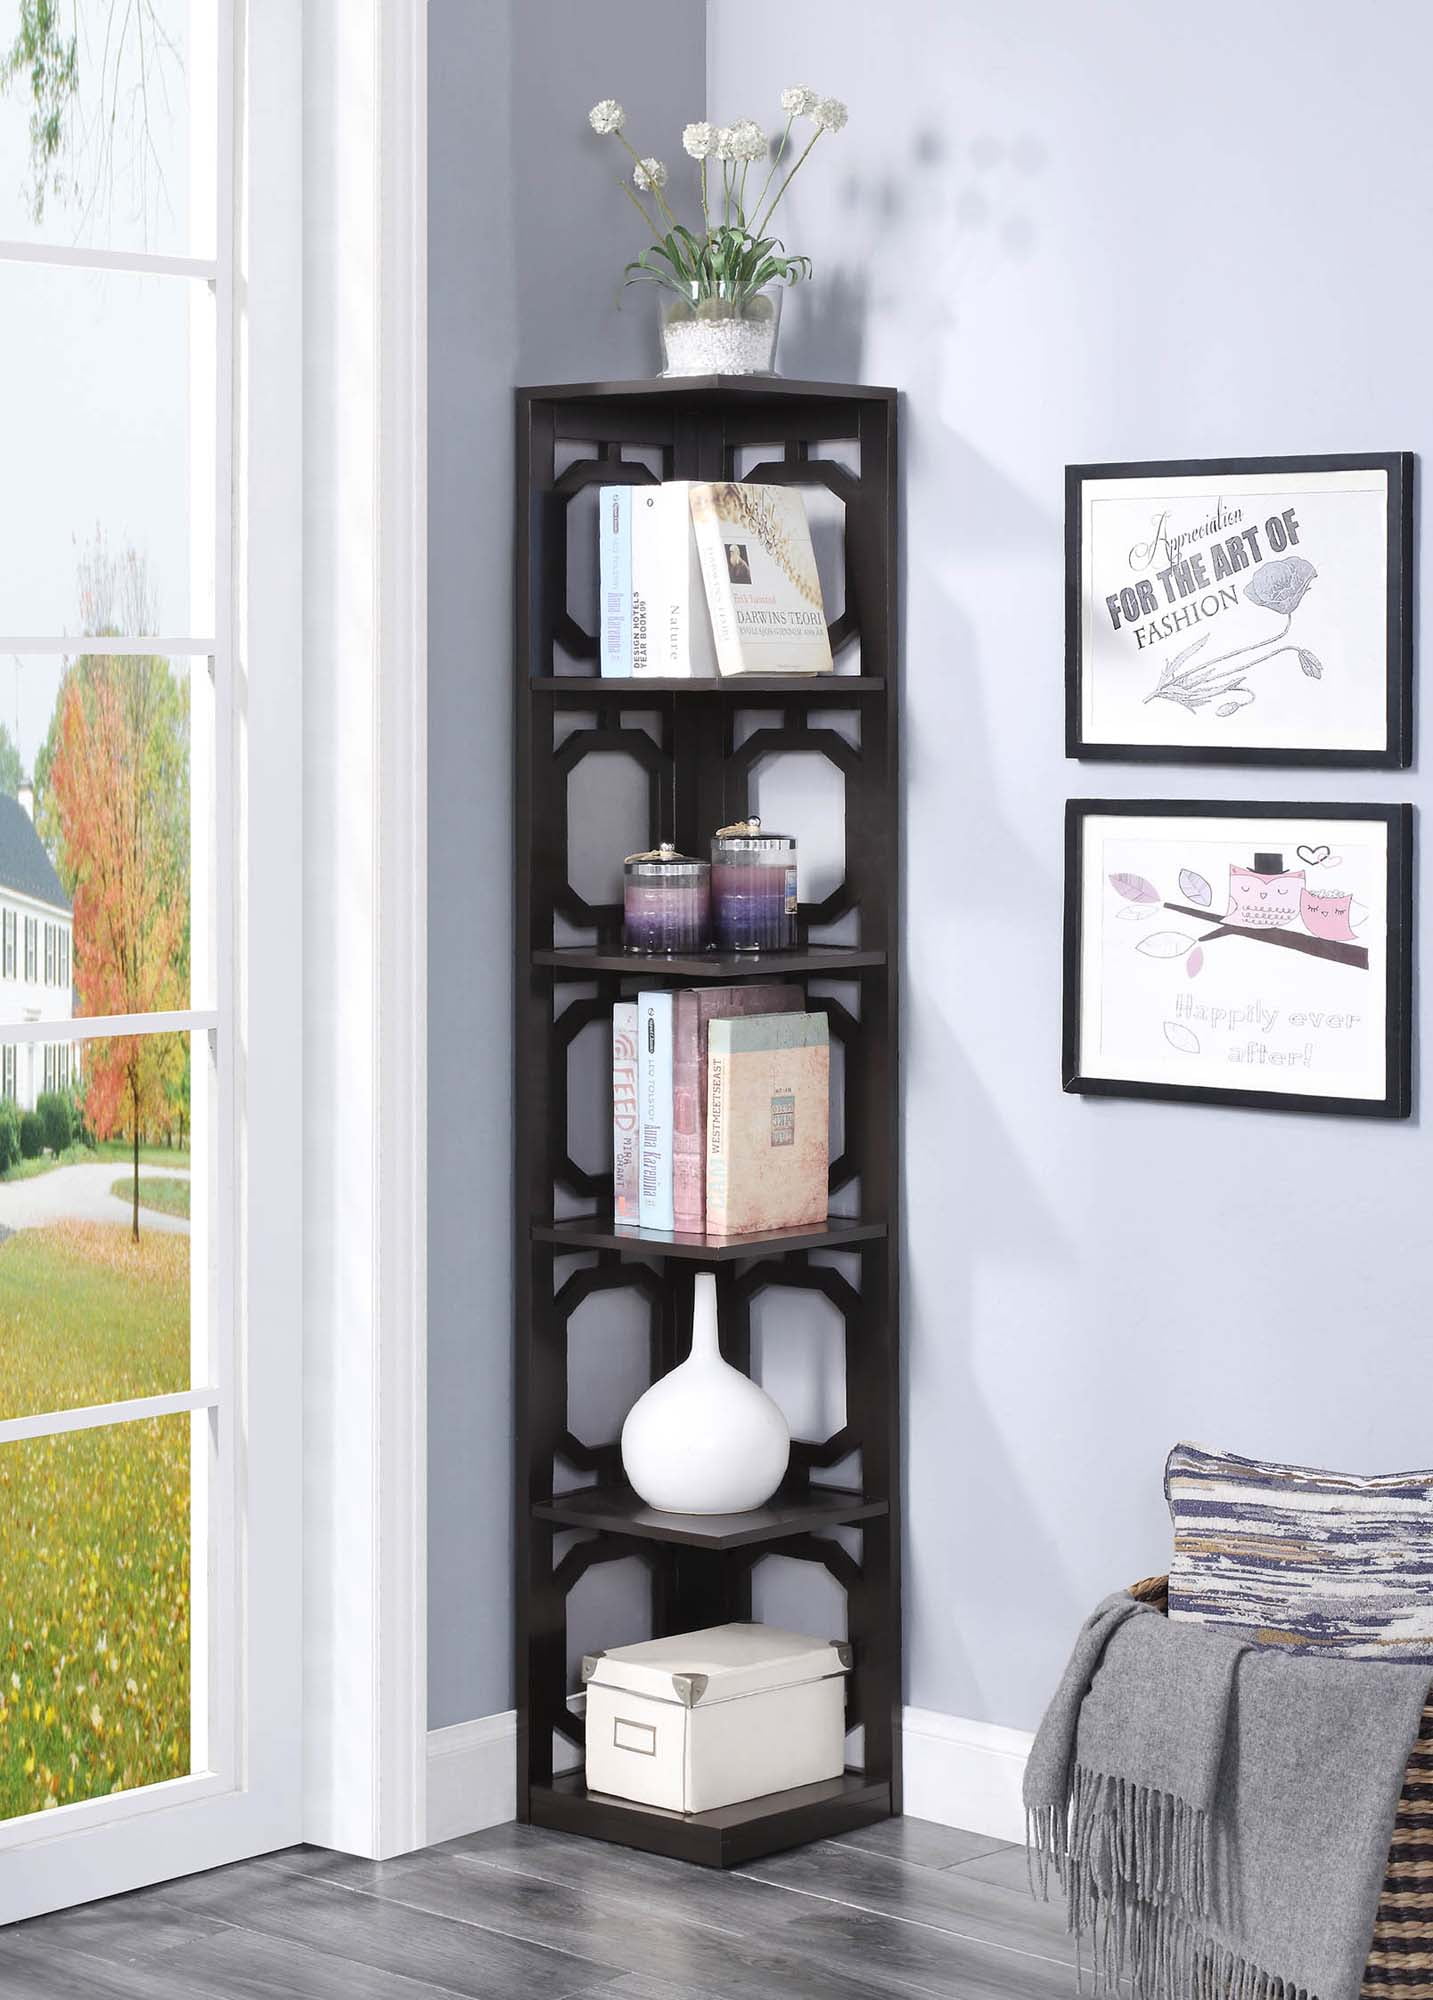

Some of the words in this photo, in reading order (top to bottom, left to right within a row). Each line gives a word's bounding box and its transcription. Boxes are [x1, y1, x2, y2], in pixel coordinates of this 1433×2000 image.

[1128, 496, 1244, 576] Appreciation
[1105, 579, 1159, 631] FOR
[1156, 553, 1211, 604] THE
[1211, 526, 1263, 582] ART
[1264, 507, 1300, 553] OF
[632, 591, 640, 629] HOTELS
[736, 610, 787, 625] DARWINS
[788, 611, 823, 626] TEORI
[1133, 584, 1240, 650] FASHION
[632, 632, 640, 669] DESIGN
[670, 605, 680, 660] Nature
[639, 642, 648, 669] YEAR
[1175, 993, 1279, 1032] Happily
[1288, 1011, 1362, 1029] ever
[1227, 1042, 1314, 1068] after!
[614, 1067, 637, 1131] FEED
[711, 1058, 723, 1154] WESTMEETSEAST
[623, 1137, 632, 1166] MIRA
[643, 1123, 661, 1148] Anna
[616, 1153, 625, 1188] GRANT
[642, 1151, 661, 1197] Karenina
